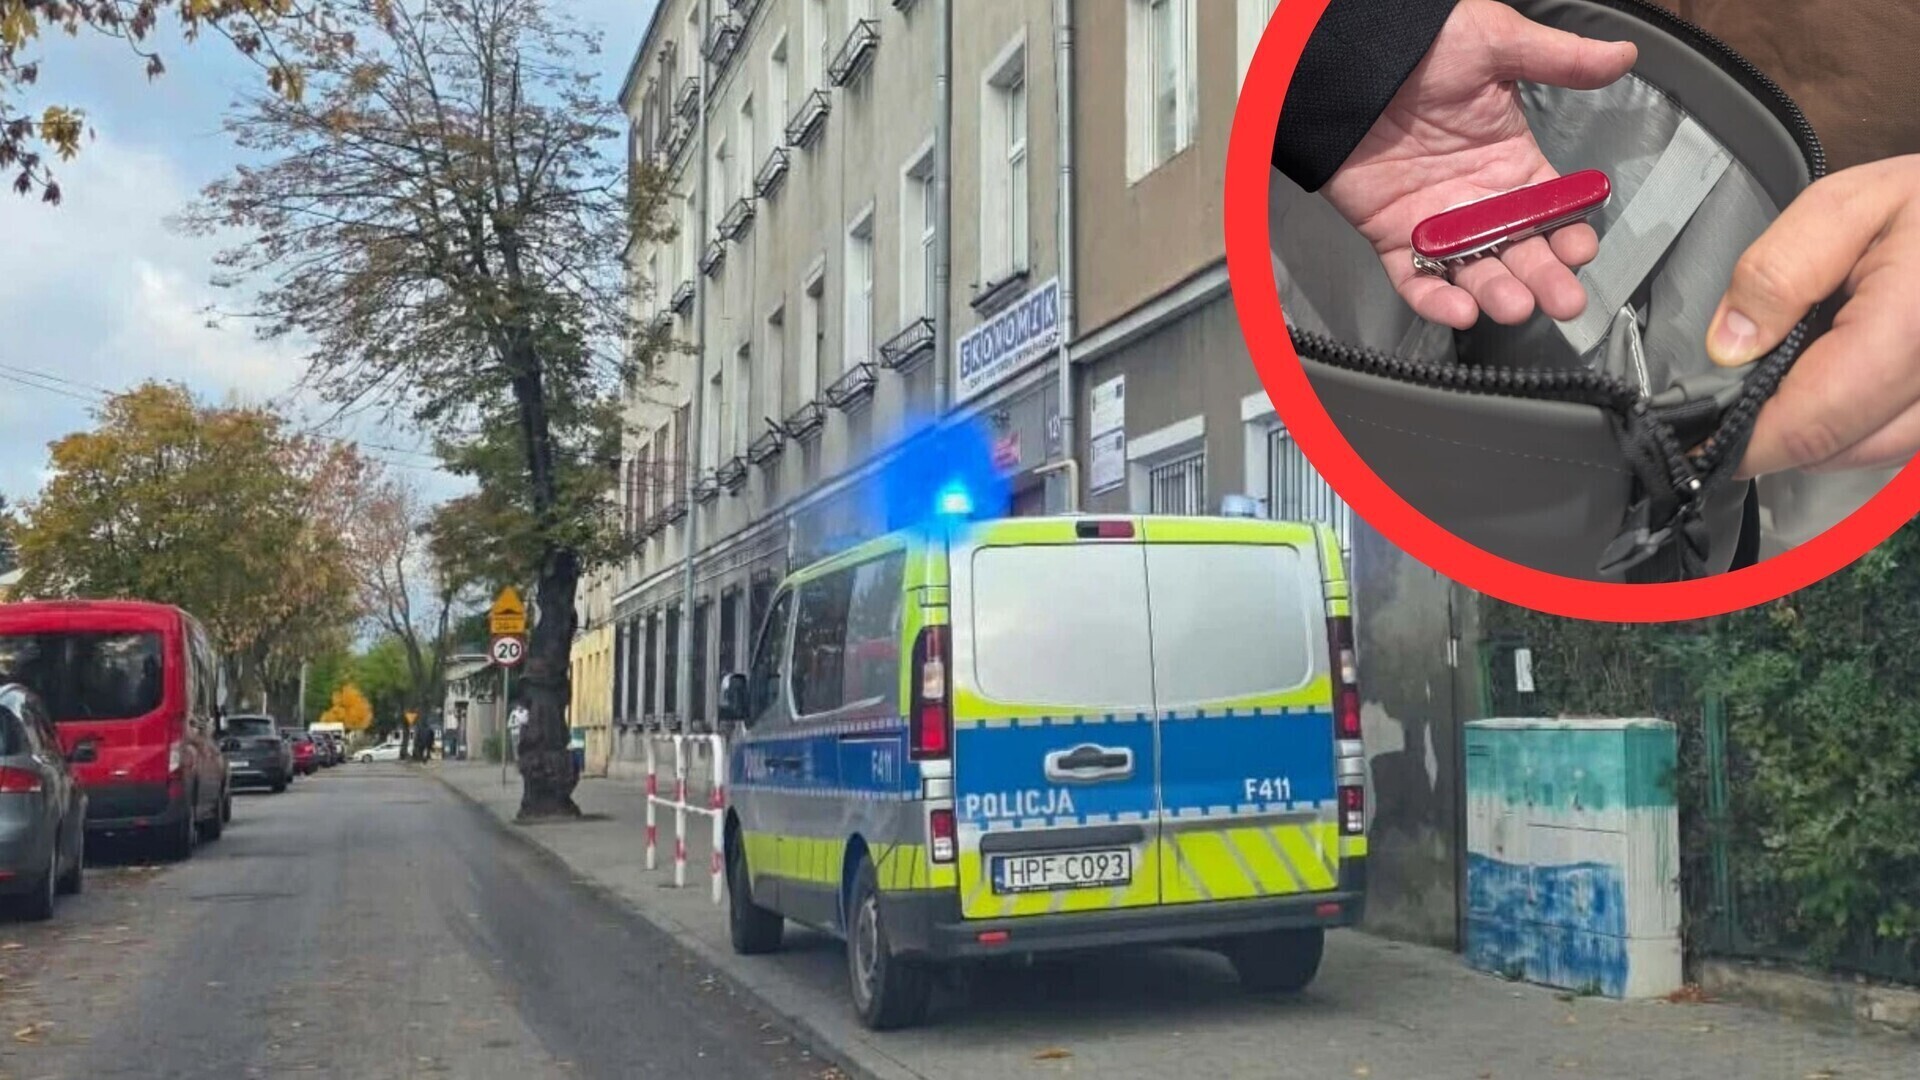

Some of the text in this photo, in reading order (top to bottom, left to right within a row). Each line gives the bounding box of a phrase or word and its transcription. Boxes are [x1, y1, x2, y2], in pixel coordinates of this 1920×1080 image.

[961, 287, 1056, 376] EKONOMIK
[498, 643, 520, 659] 20
[872, 749, 892, 782] F411
[966, 788, 1075, 819] POLICJA
[1245, 777, 1291, 801] F411
[1010, 857, 1056, 885] HPF
[1065, 853, 1124, 881] C093
